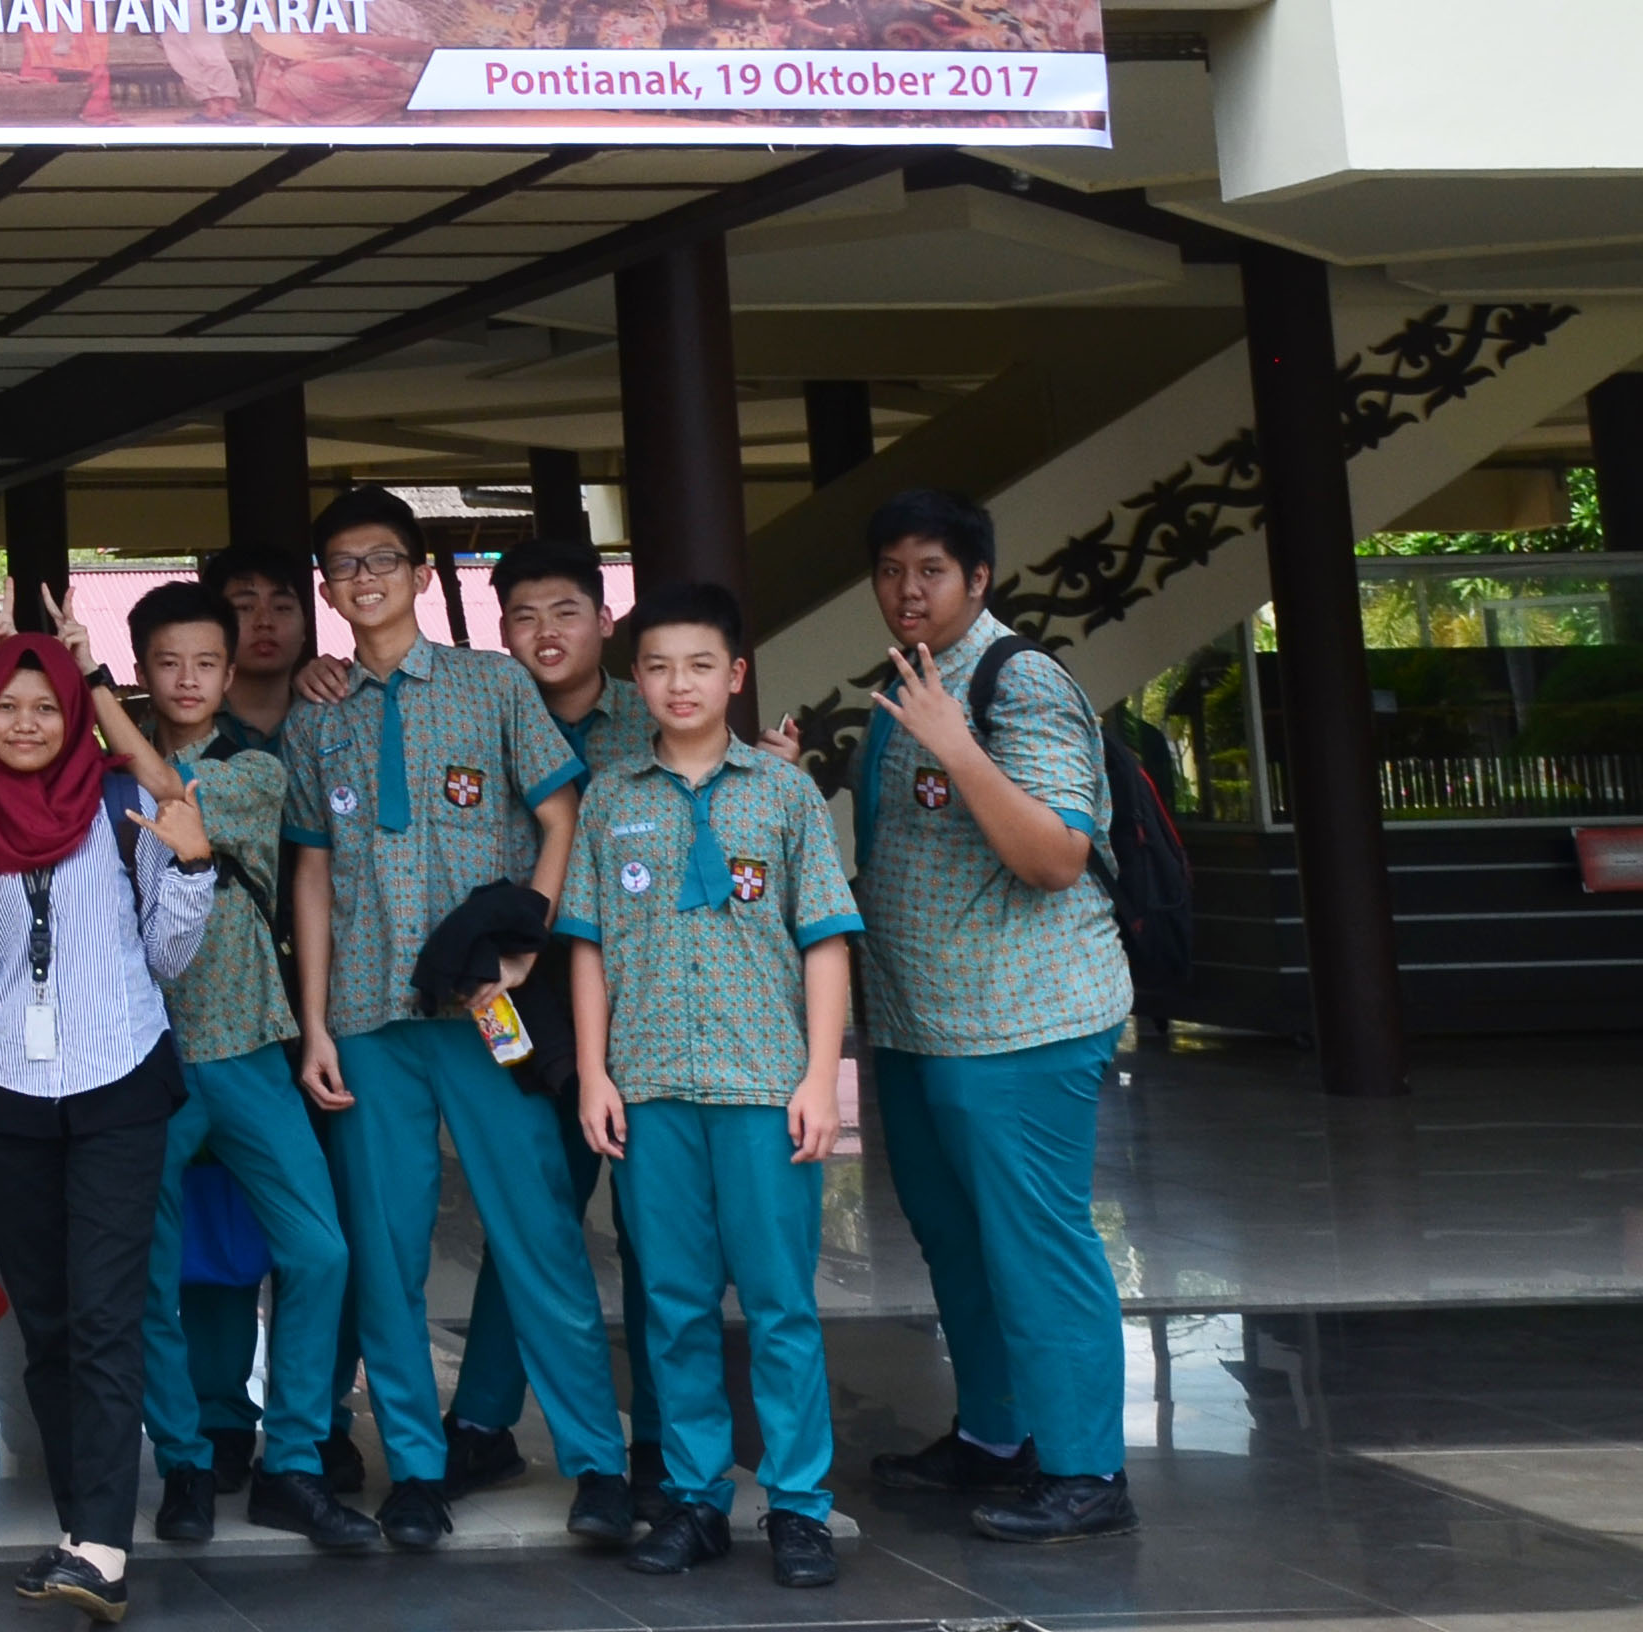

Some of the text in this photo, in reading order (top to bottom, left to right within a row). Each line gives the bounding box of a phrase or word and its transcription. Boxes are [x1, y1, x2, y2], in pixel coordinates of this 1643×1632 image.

[485, 60, 1040, 101] Pontianak, 19 Oktober 2017
